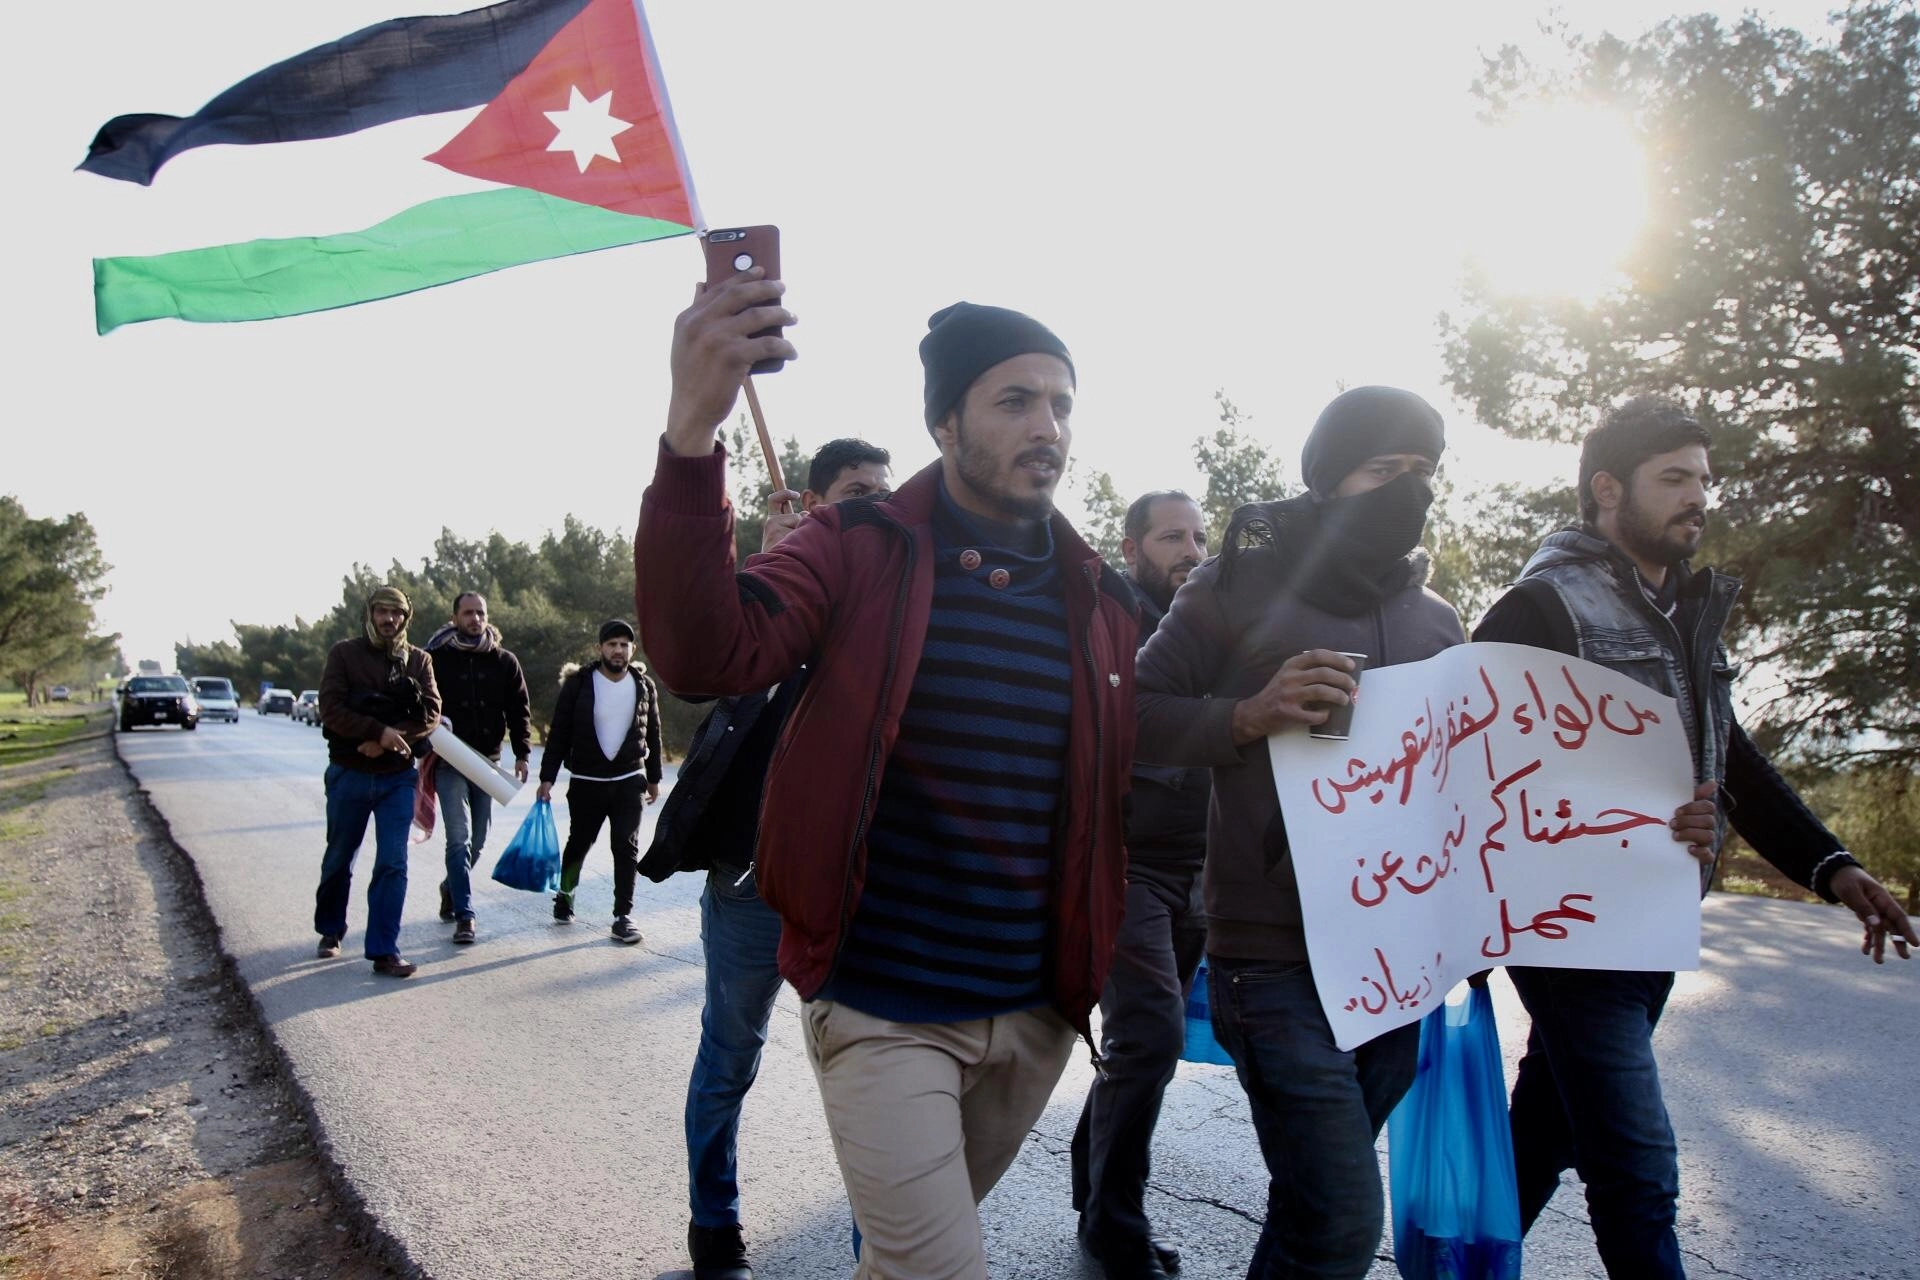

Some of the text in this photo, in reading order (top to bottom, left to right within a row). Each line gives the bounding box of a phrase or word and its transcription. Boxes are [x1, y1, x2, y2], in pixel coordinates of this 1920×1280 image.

[1512, 664, 1594, 750] لواء
[1597, 693, 1661, 736] من
[1351, 758, 1668, 908] جئناكم نبحث عن
[1481, 893, 1597, 958] عمل
